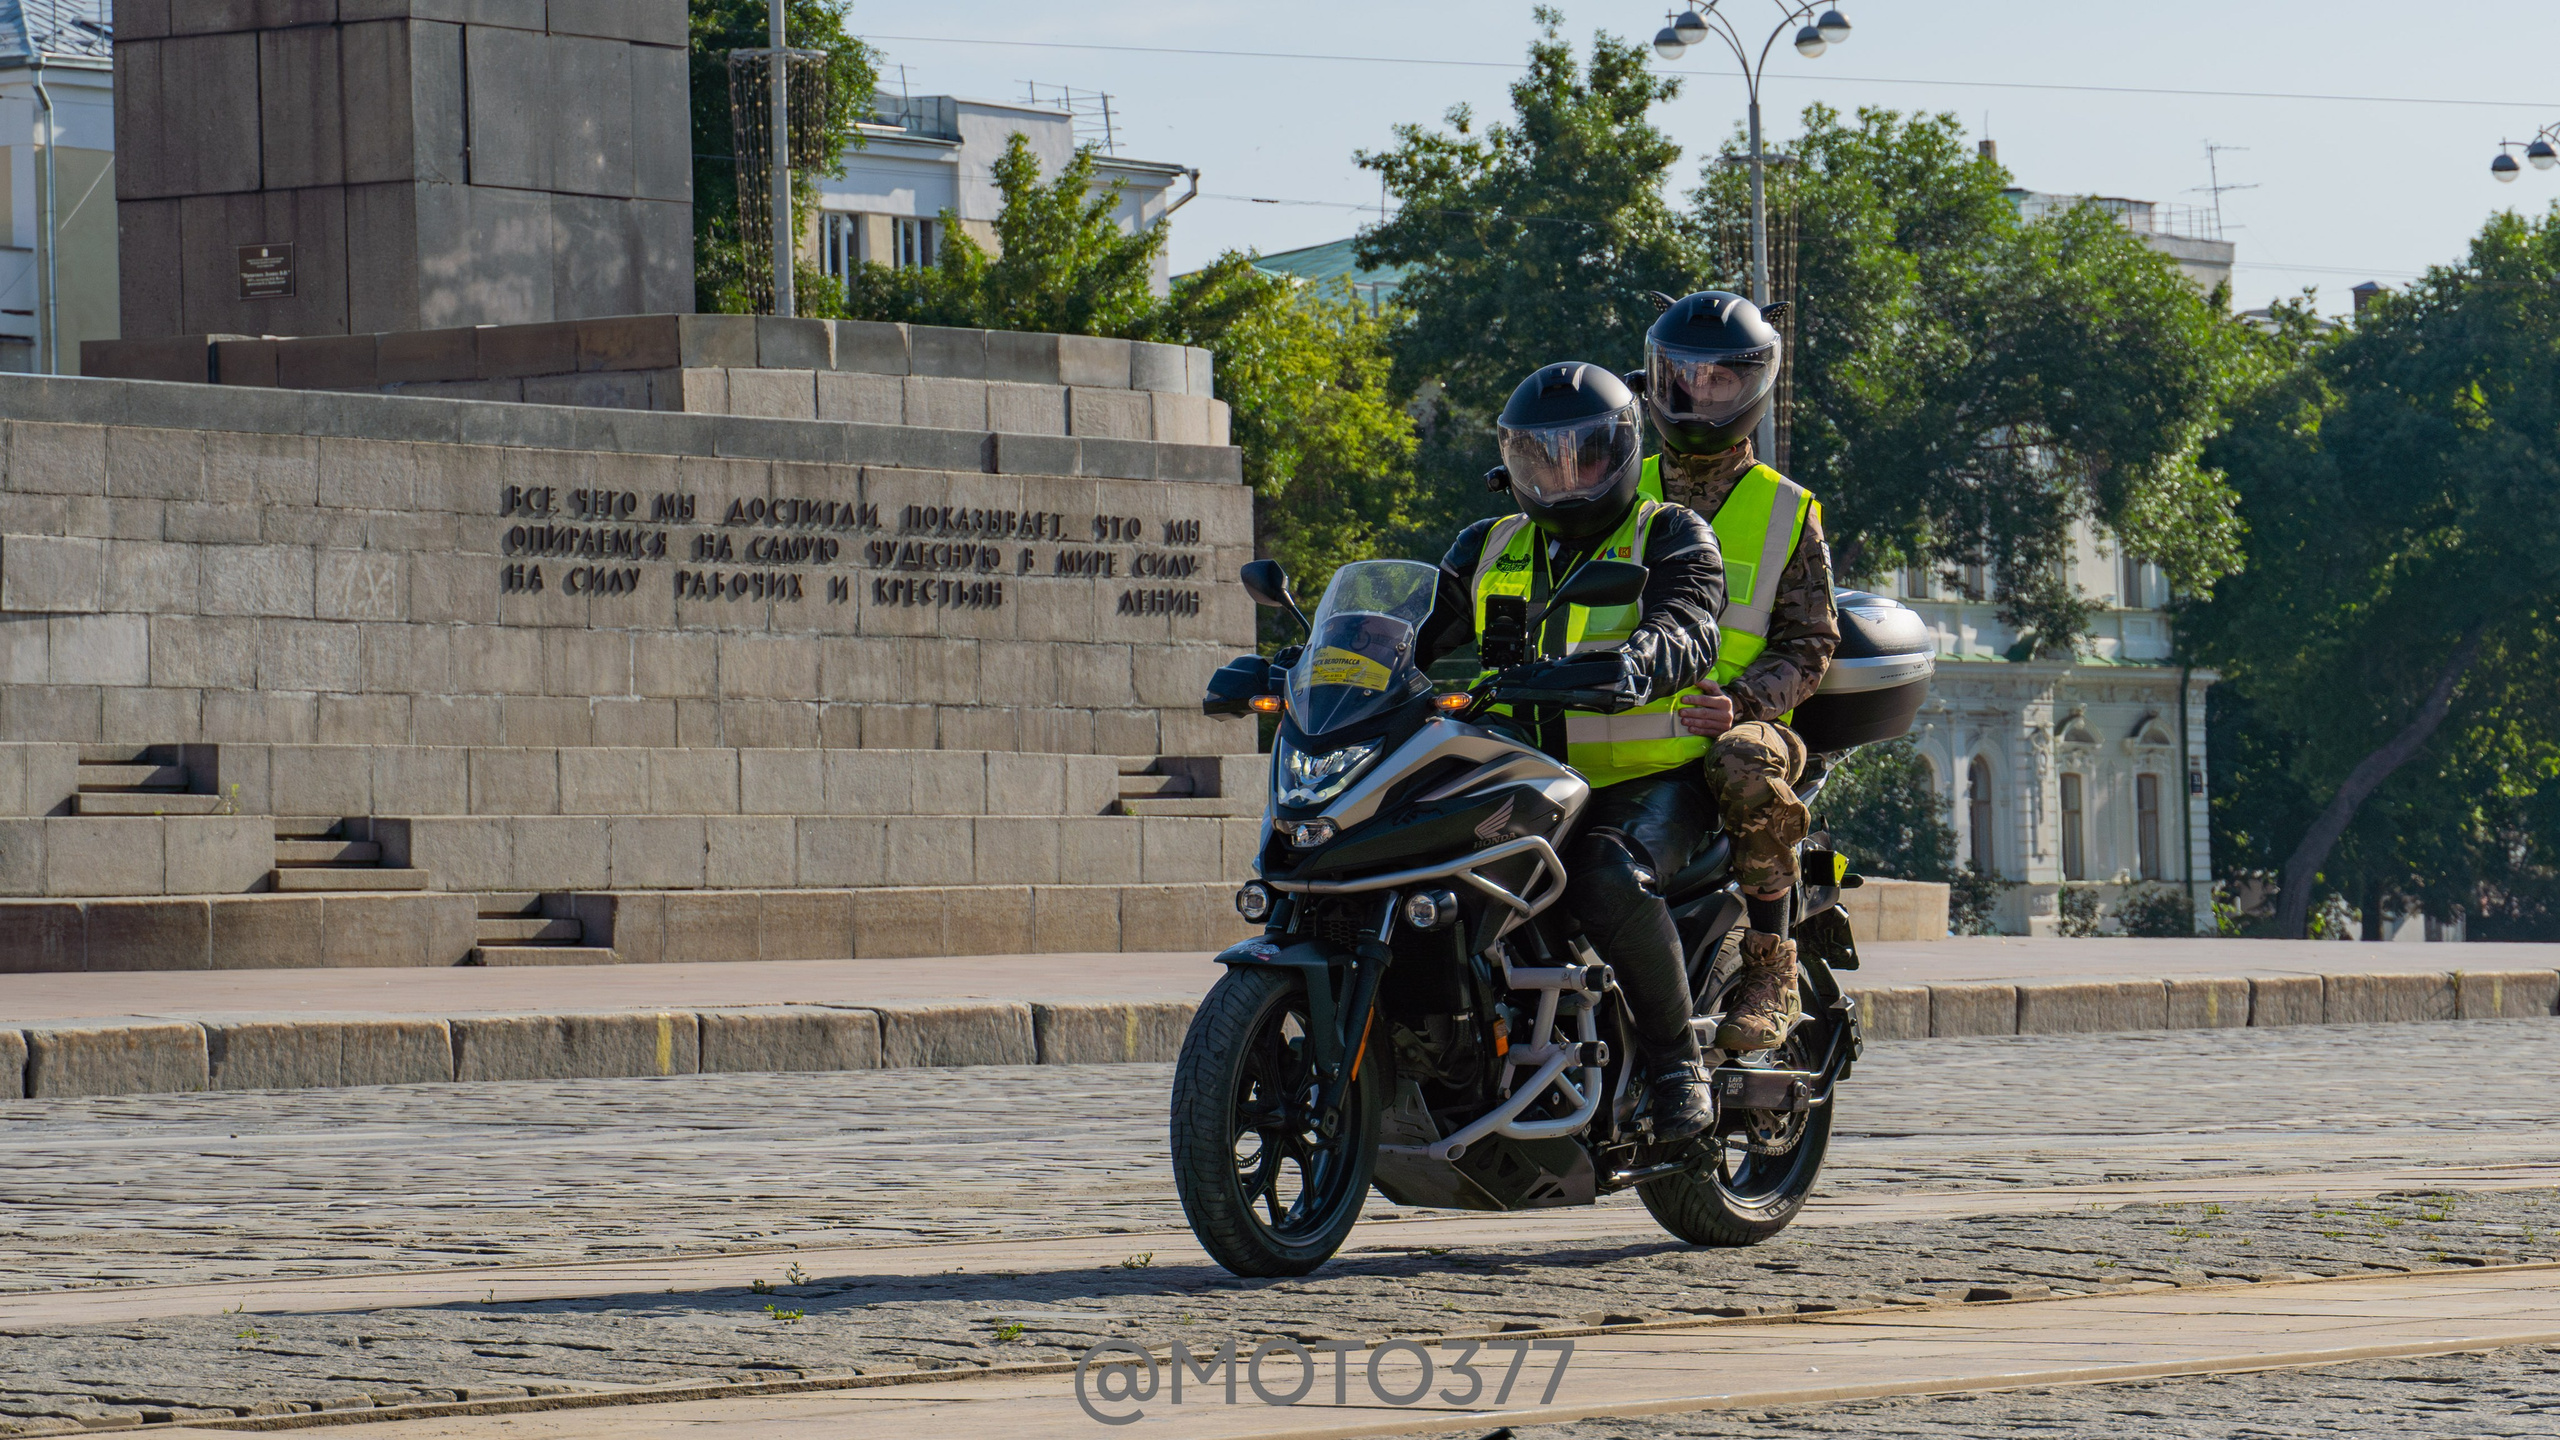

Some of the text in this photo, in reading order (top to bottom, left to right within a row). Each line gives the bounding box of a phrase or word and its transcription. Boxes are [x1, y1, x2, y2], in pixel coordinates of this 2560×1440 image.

[571, 489, 637, 517] ЧЕГО
[656, 493, 696, 521] МЫ
[1095, 514, 1142, 541] ЧТО
[1166, 519, 1200, 544] МЫ
[507, 525, 667, 558] ОПИРАЕМСЯ
[697, 532, 734, 560] НА
[750, 535, 840, 562] САМУЮ
[868, 540, 1001, 570] ЧУДЕСНУЮ
[1021, 547, 1035, 572] В
[1057, 549, 1118, 576] МИРЕ
[507, 564, 544, 592] НА
[567, 566, 641, 594] СИЛУ
[677, 569, 804, 600] РАБОЧИХ
[831, 575, 848, 602] И
[1118, 588, 1200, 616] ЛЕНИН
[1472, 832, 1517, 850] HONDA
